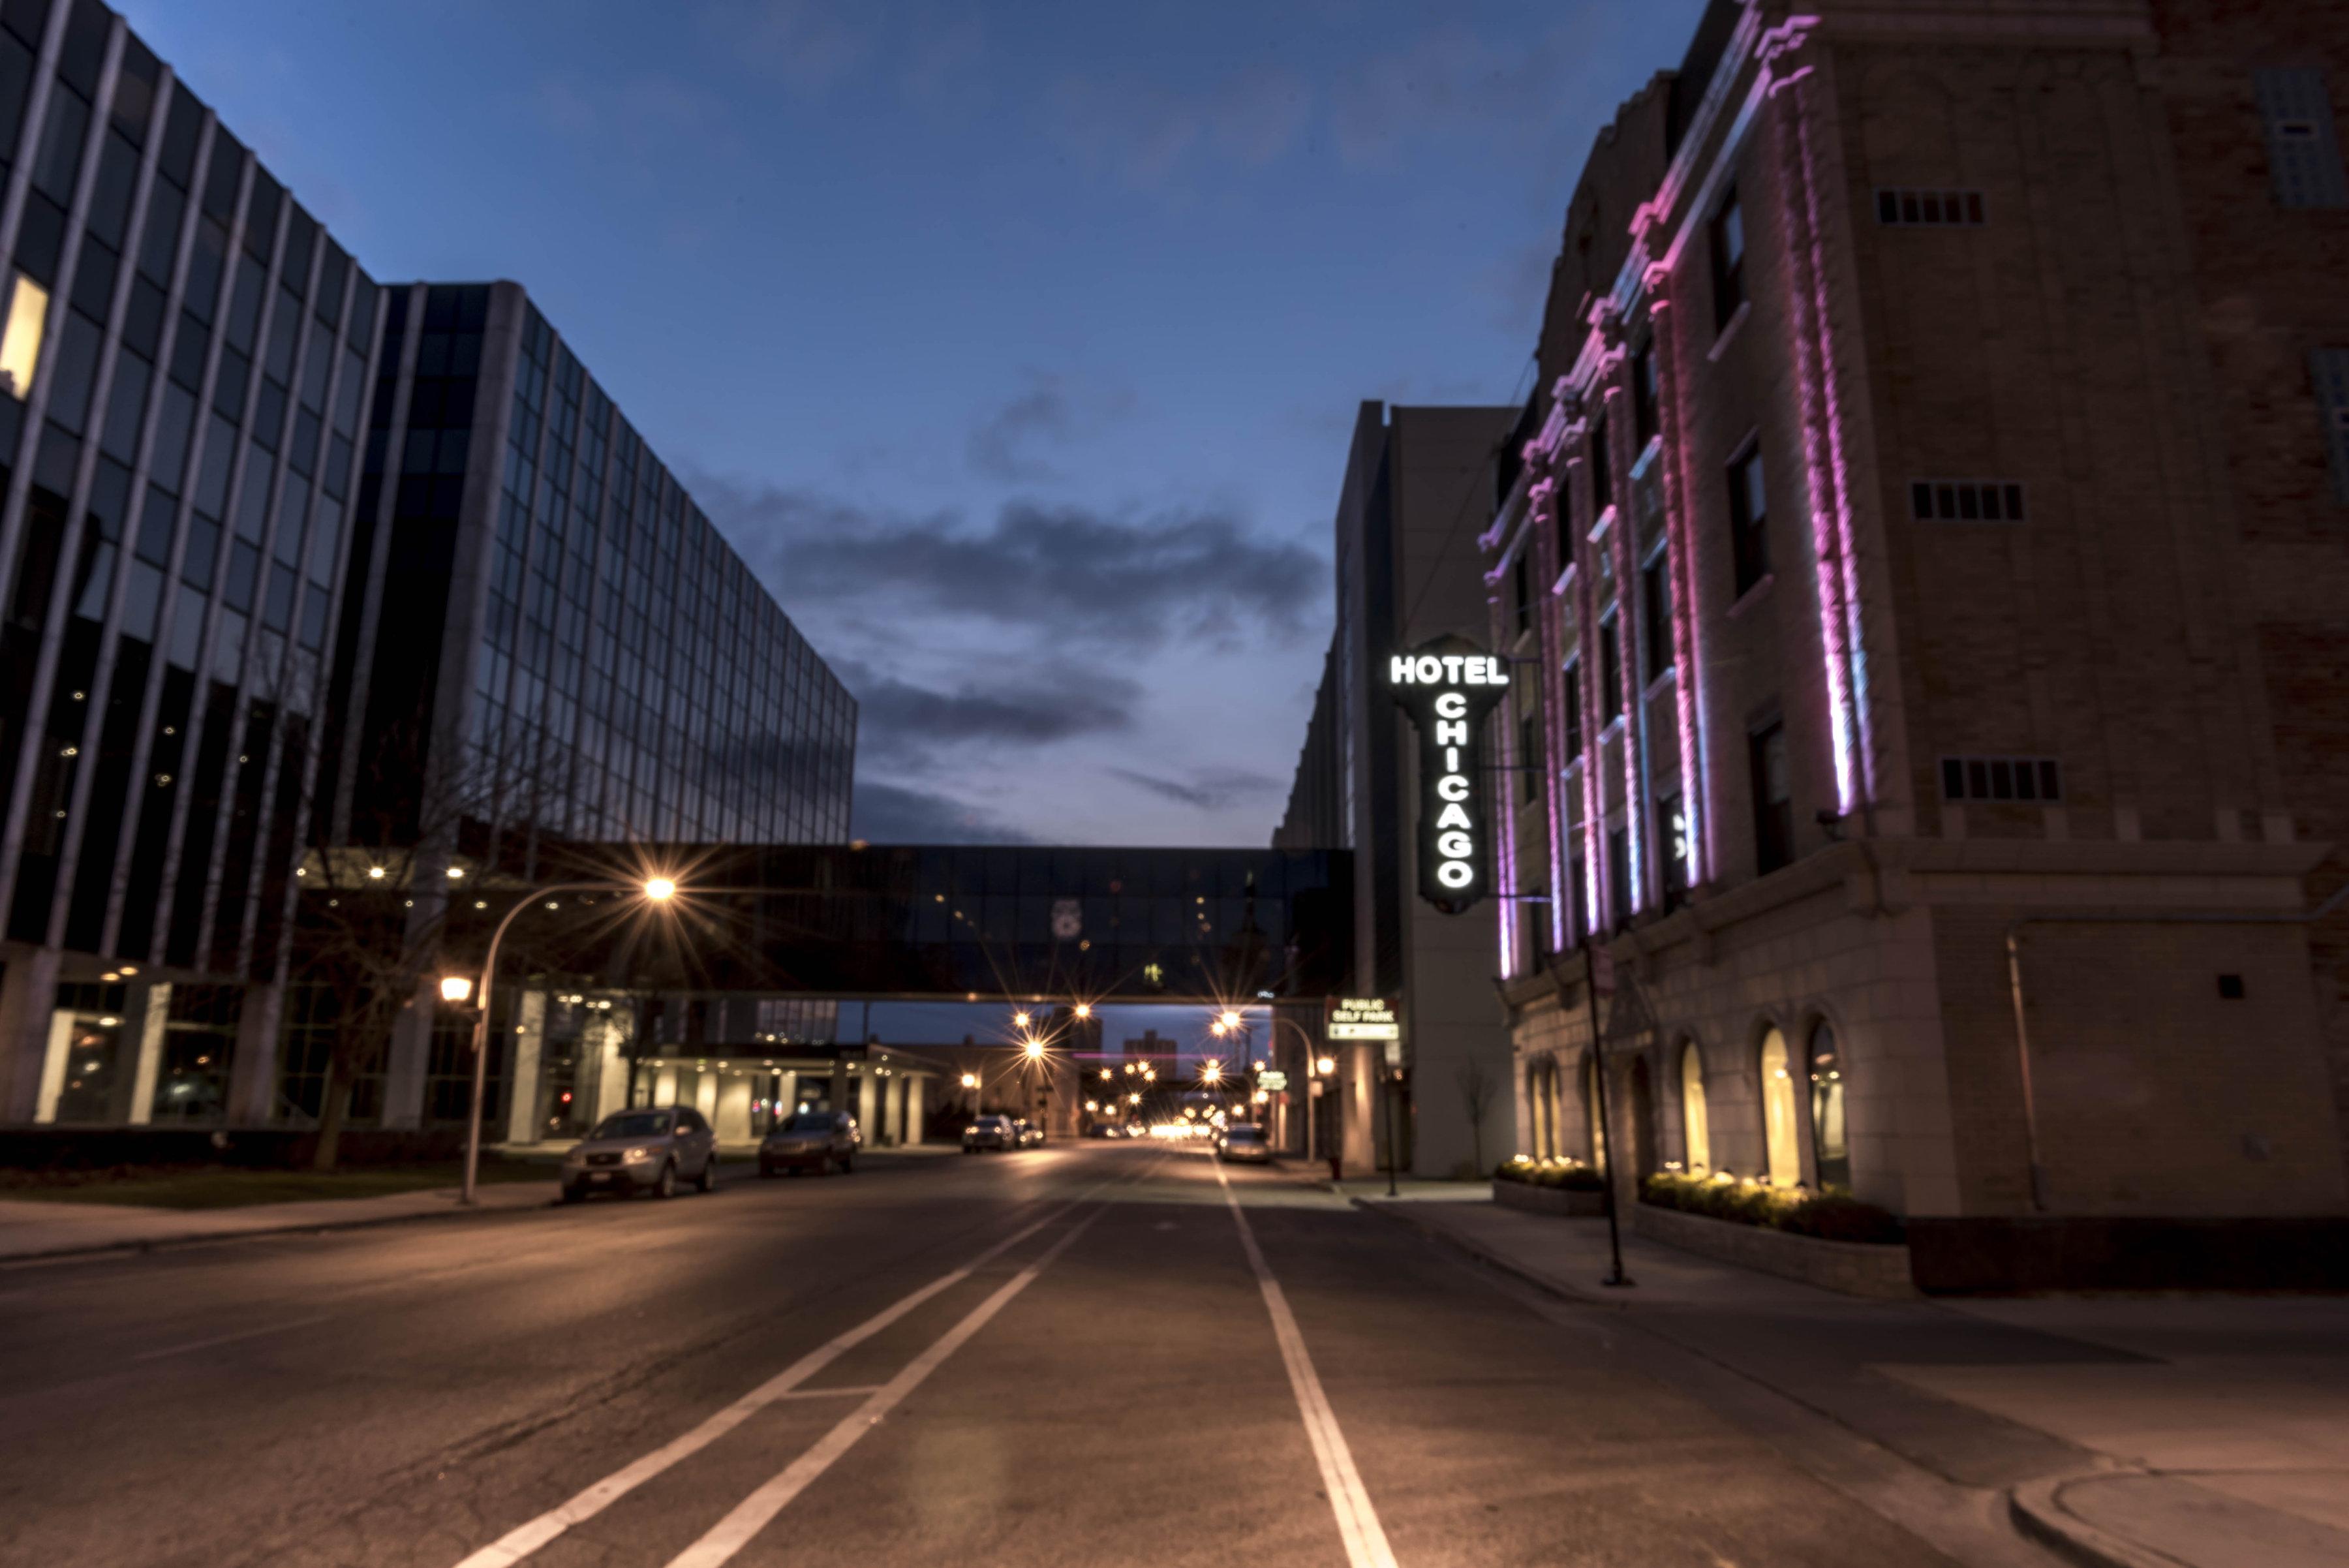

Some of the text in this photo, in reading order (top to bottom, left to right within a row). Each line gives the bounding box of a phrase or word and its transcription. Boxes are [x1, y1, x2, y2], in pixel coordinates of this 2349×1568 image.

[1390, 655, 1509, 685] HOTEL
[1434, 692, 1473, 889] CHICAGO
[1342, 999, 1384, 1011] PUBLIC
[1333, 1011, 1393, 1022] SELF PARK
